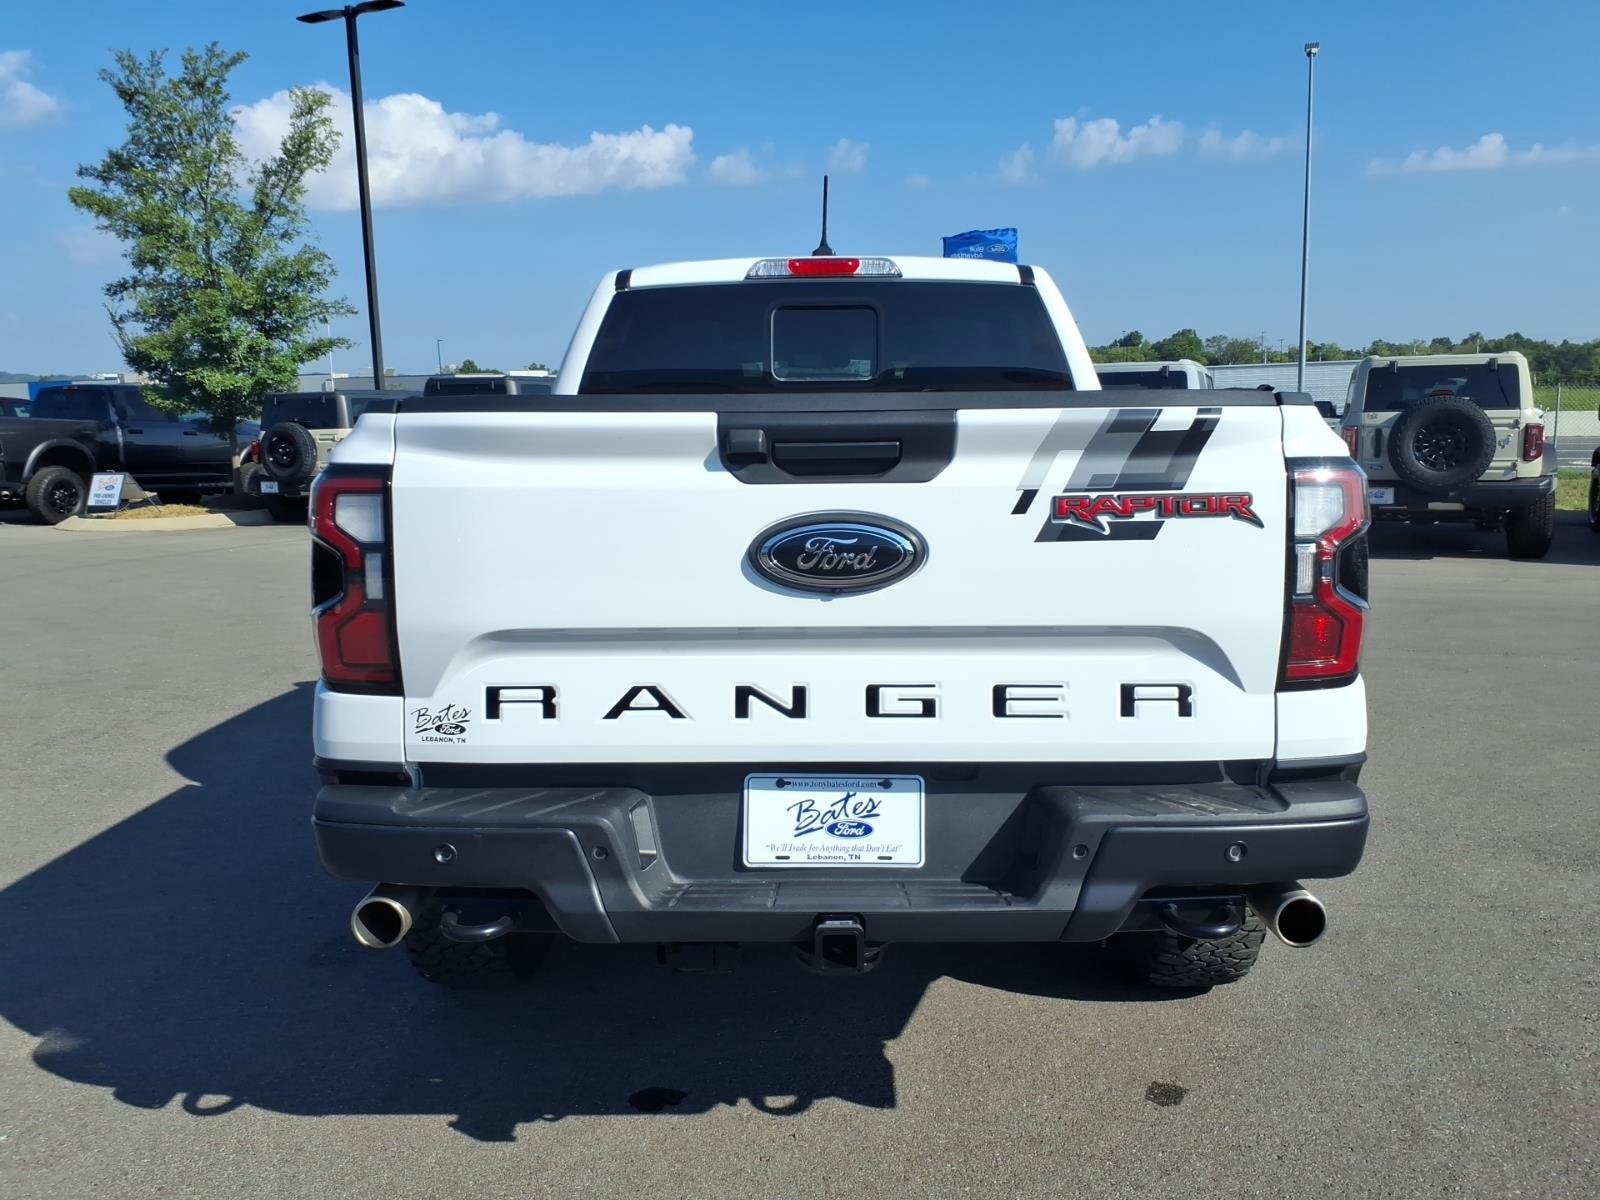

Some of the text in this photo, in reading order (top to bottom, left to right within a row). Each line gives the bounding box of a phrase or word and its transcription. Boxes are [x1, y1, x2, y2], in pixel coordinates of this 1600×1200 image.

[1050, 492, 1265, 534] RAPTOR
[796, 536, 878, 570] Ford
[485, 683, 1193, 719] RANGER
[410, 704, 472, 729] Bates
[440, 723, 462, 734] Ford
[421, 736, 456, 744] LEBANON,
[787, 792, 882, 831] Bates
[834, 821, 865, 836] Ford
